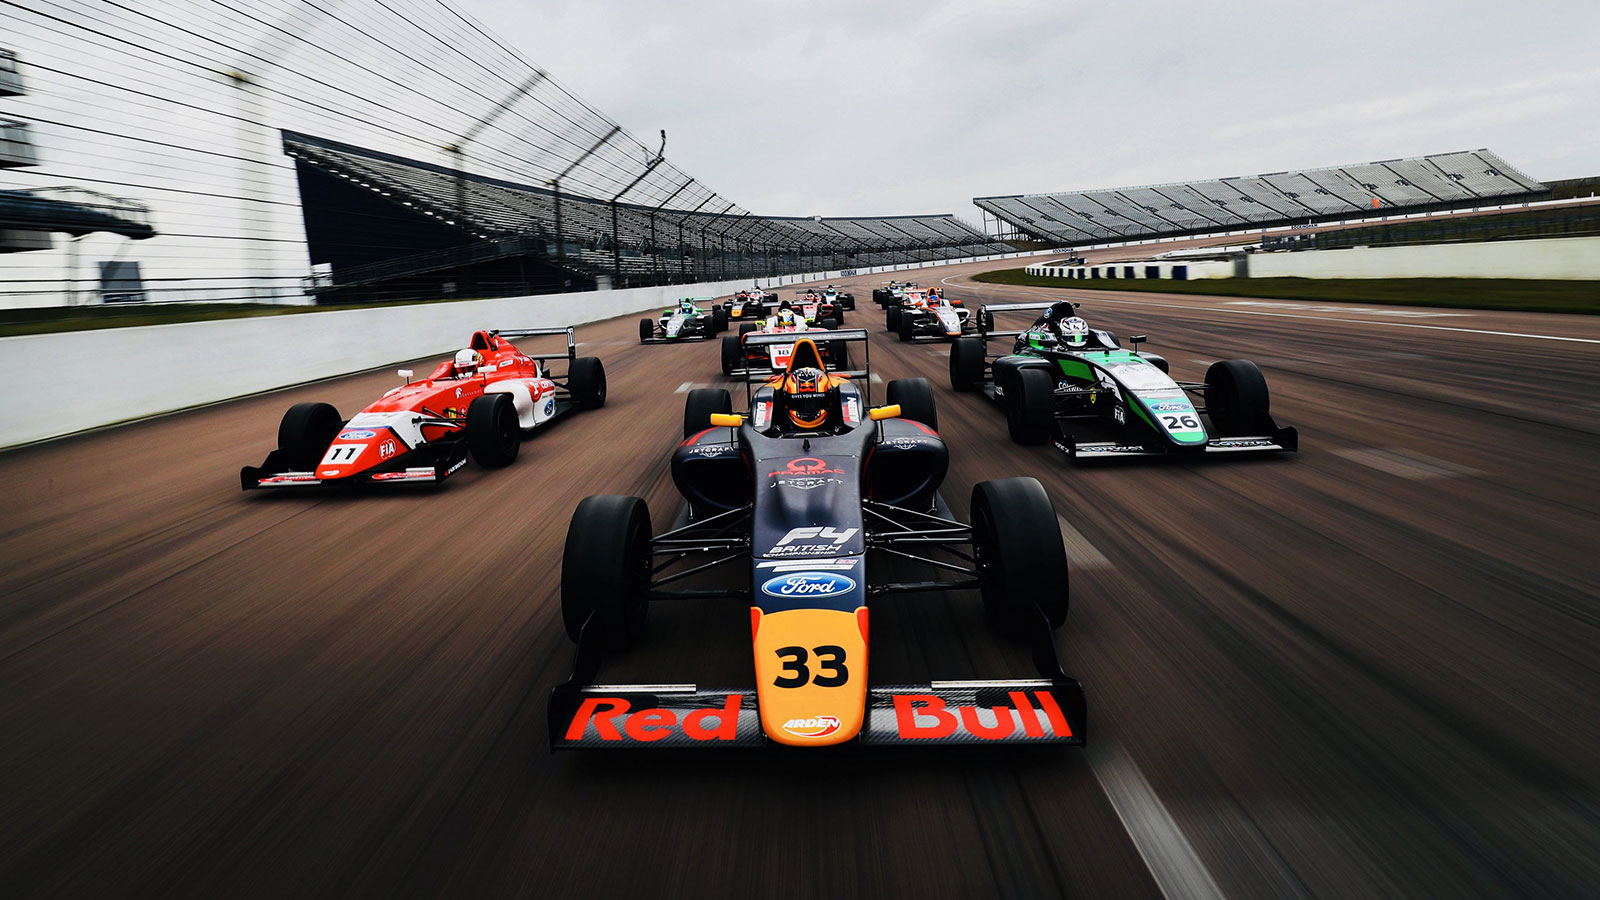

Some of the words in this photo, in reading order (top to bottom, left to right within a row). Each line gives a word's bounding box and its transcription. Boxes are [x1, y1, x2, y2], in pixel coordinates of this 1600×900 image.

[1114, 408, 1125, 425] FIA
[1162, 415, 1198, 429] 26
[331, 448, 357, 460] 11
[380, 441, 395, 457] FIA
[770, 478, 844, 488] JETCRAFT
[776, 526, 859, 546] F4
[769, 545, 842, 554] BRITISH
[780, 576, 837, 595] Ford
[773, 645, 849, 689] 33
[564, 694, 743, 742] Red
[892, 690, 1073, 740] Bull
[782, 717, 840, 729] ARDEN
